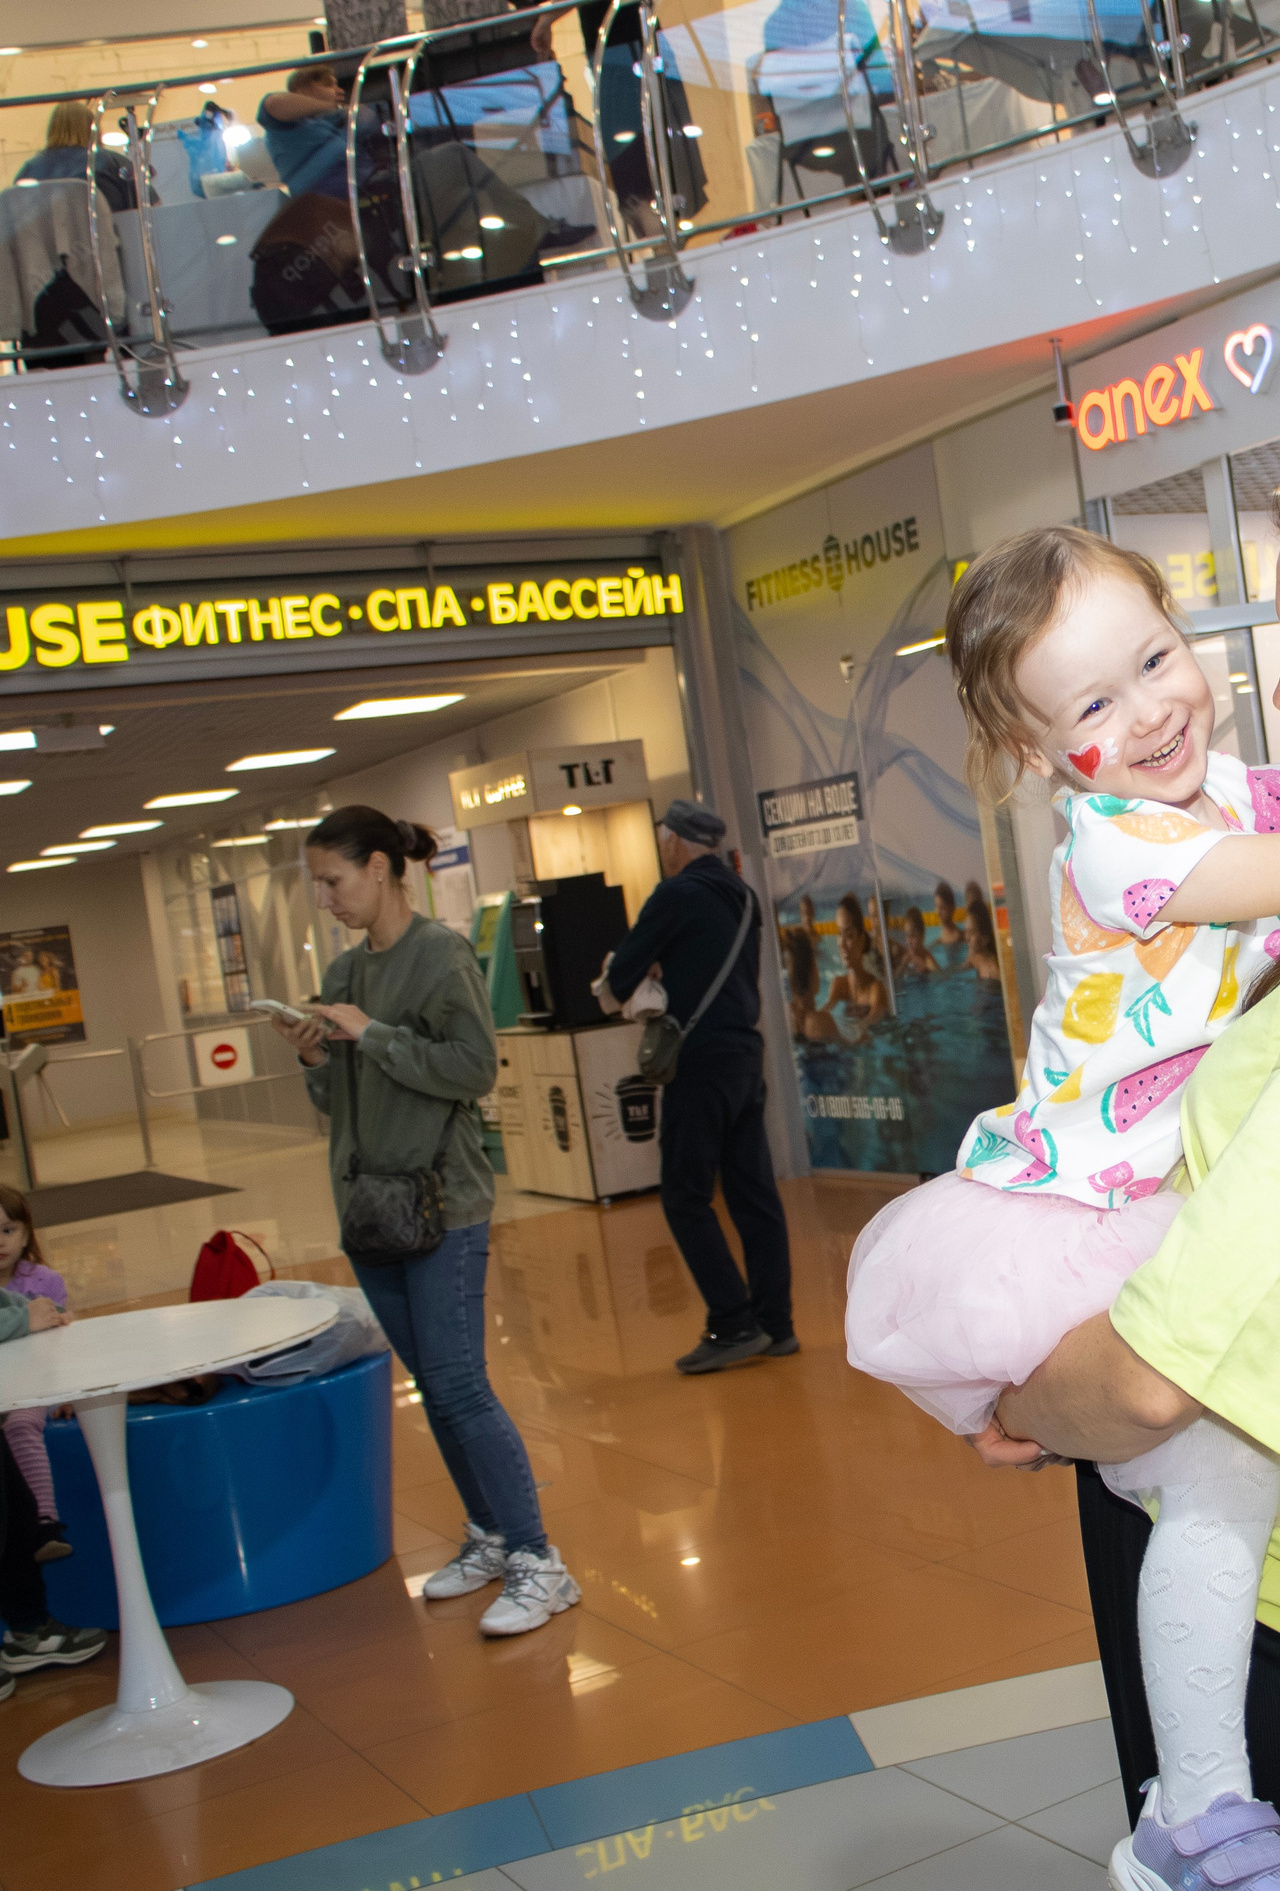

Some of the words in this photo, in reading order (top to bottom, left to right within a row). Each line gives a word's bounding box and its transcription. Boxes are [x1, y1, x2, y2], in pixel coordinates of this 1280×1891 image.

[1076, 347, 1213, 450] anex
[132, 593, 343, 649] ФИТНЕС
[366, 586, 467, 632] СПА
[487, 566, 684, 625] БАССЕЙН
[745, 554, 824, 612] FITNESS
[844, 516, 919, 576] HOUSE
[764, 793, 805, 826] СЕКЦИИ
[807, 788, 822, 818] НА
[825, 782, 857, 815] ВОДЕ
